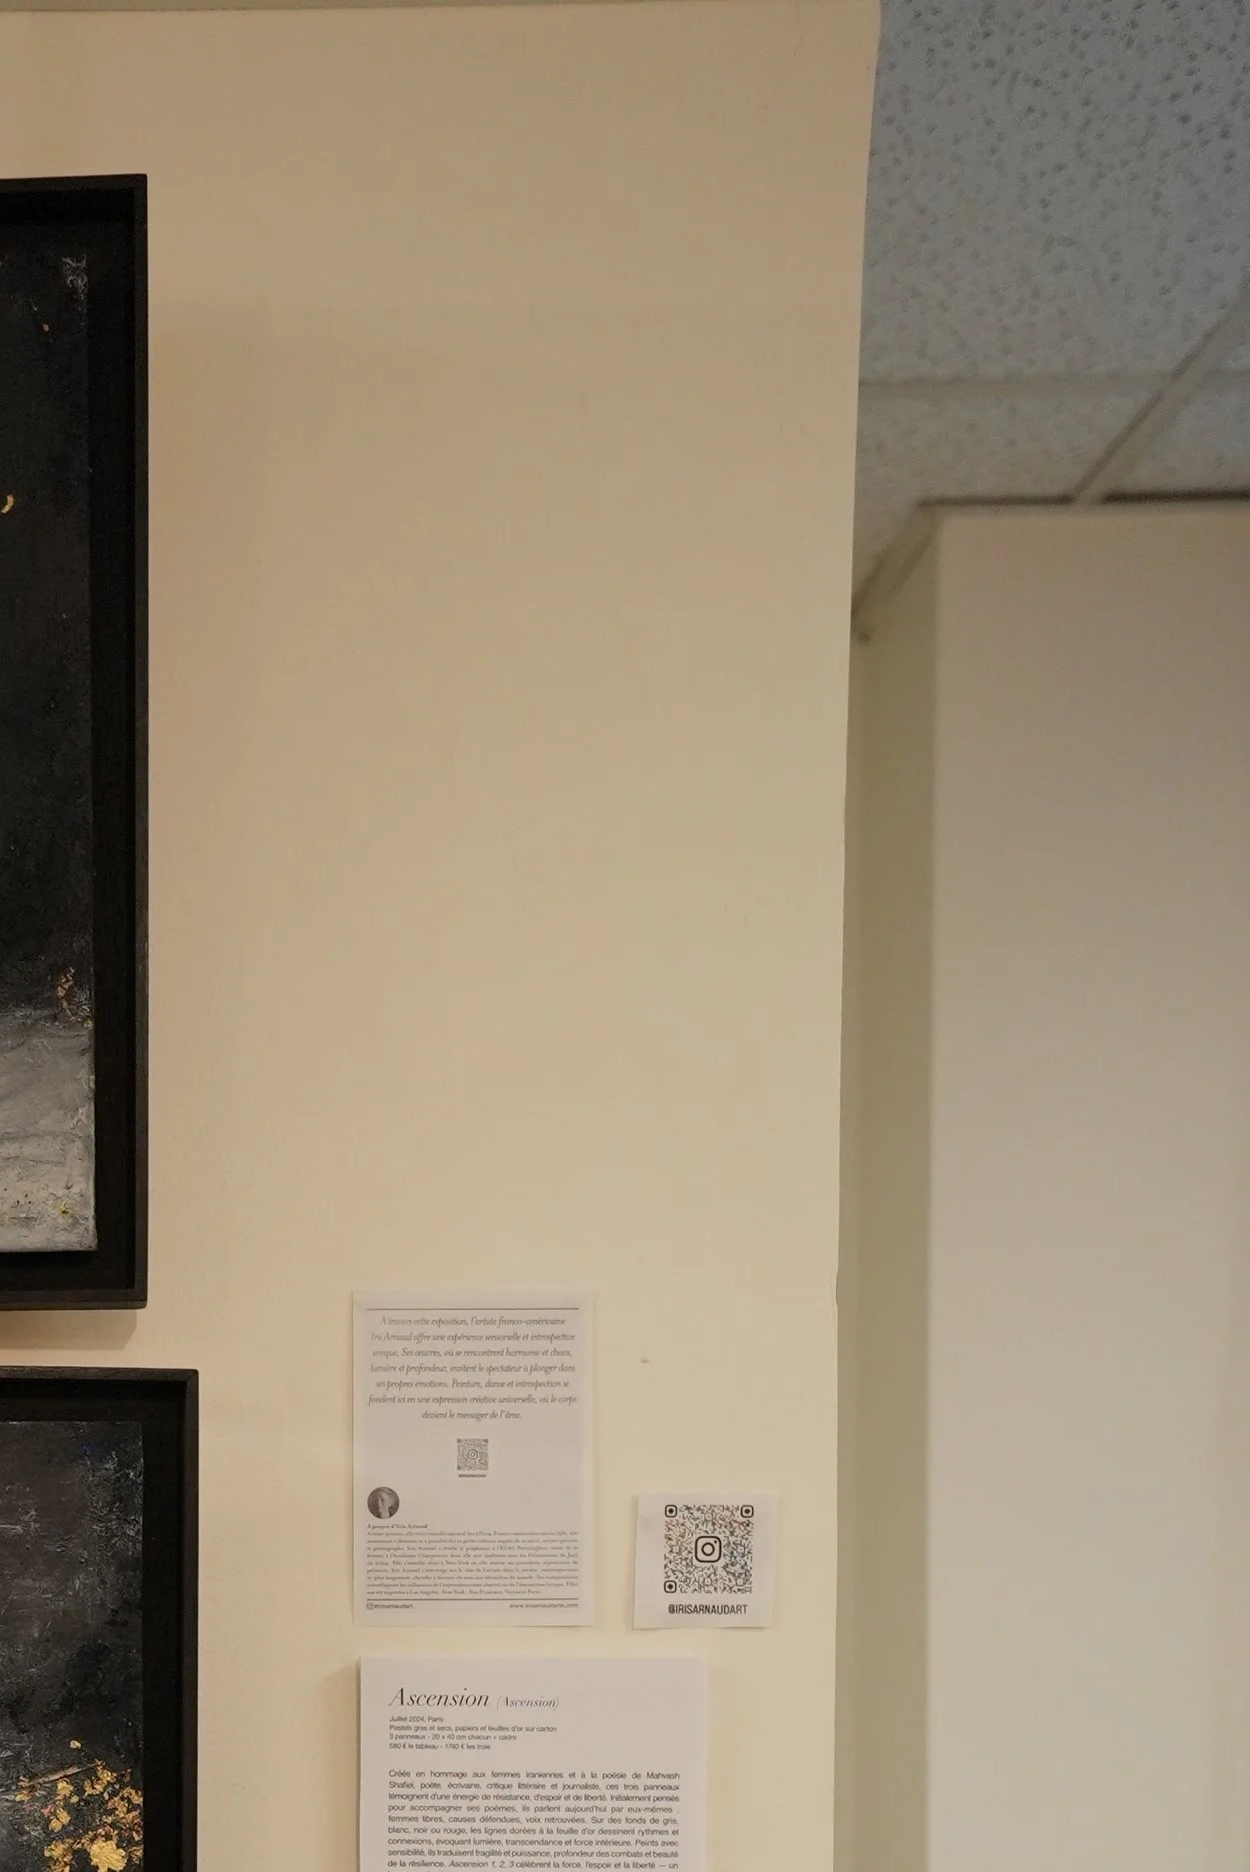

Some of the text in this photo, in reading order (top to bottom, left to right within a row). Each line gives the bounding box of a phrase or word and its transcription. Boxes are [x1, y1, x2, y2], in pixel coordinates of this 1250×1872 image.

[668, 1604, 748, 1615] @IRISARNAUDART
[388, 1687, 559, 1711] Ascension (Ascension)
[430, 1770, 467, 1780] hommage
[491, 1770, 520, 1778] femmes
[525, 1770, 563, 1779] iraniennes
[568, 1771, 575, 1779] et
[580, 1771, 585, 1779] à
[590, 1771, 597, 1779] la
[631, 1771, 641, 1779] de
[646, 1771, 680, 1779] Mahvash
[388, 1814, 419, 1822] femmes
[525, 1815, 540, 1823] voix
[591, 1815, 604, 1824] Sur
[607, 1815, 621, 1824] des
[625, 1816, 646, 1824] fonds
[649, 1816, 659, 1824] de
[413, 1826, 427, 1834] noir
[470, 1826, 481, 1834] les
[483, 1826, 507, 1836] lignes
[538, 1826, 544, 1834] à
[546, 1826, 553, 1834] la
[556, 1826, 578, 1834] feuille
[581, 1826, 595, 1835] d'or
[597, 1827, 635, 1835] dessinent
[637, 1827, 669, 1837] rythmes
[671, 1827, 679, 1835] et
